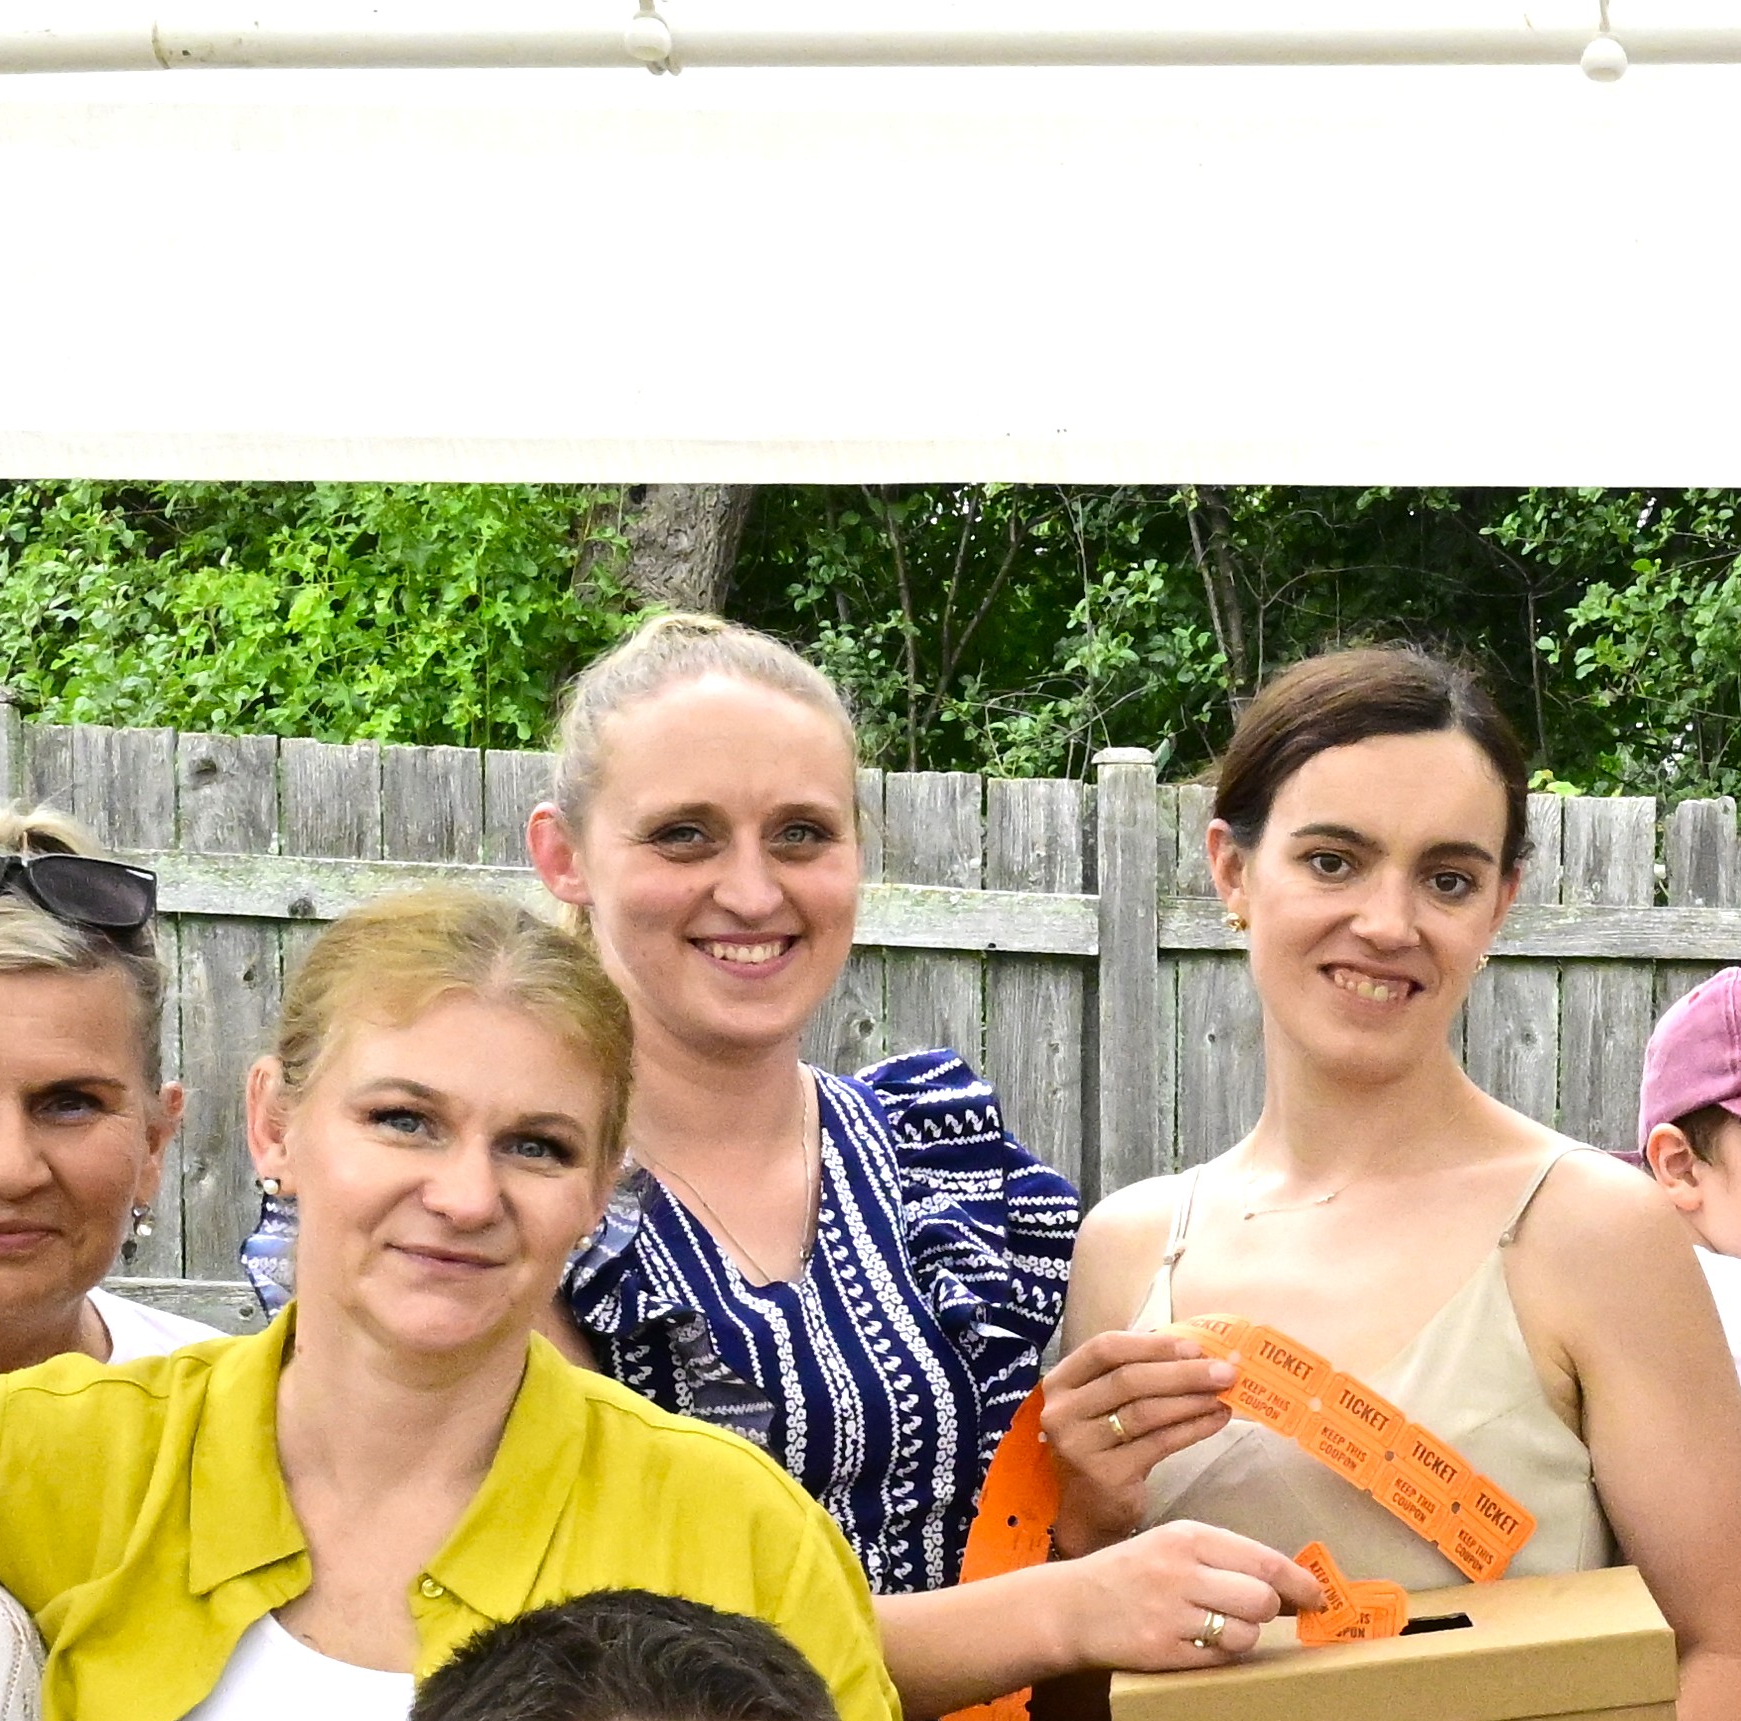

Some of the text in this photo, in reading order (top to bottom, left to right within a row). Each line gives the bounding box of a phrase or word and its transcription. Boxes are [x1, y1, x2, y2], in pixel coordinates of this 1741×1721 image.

[1259, 1340, 1313, 1381] TICKET
[1339, 1389, 1390, 1432] TICKET
[1412, 1440, 1458, 1484] TICKET
[1474, 1492, 1519, 1535] TICKET
